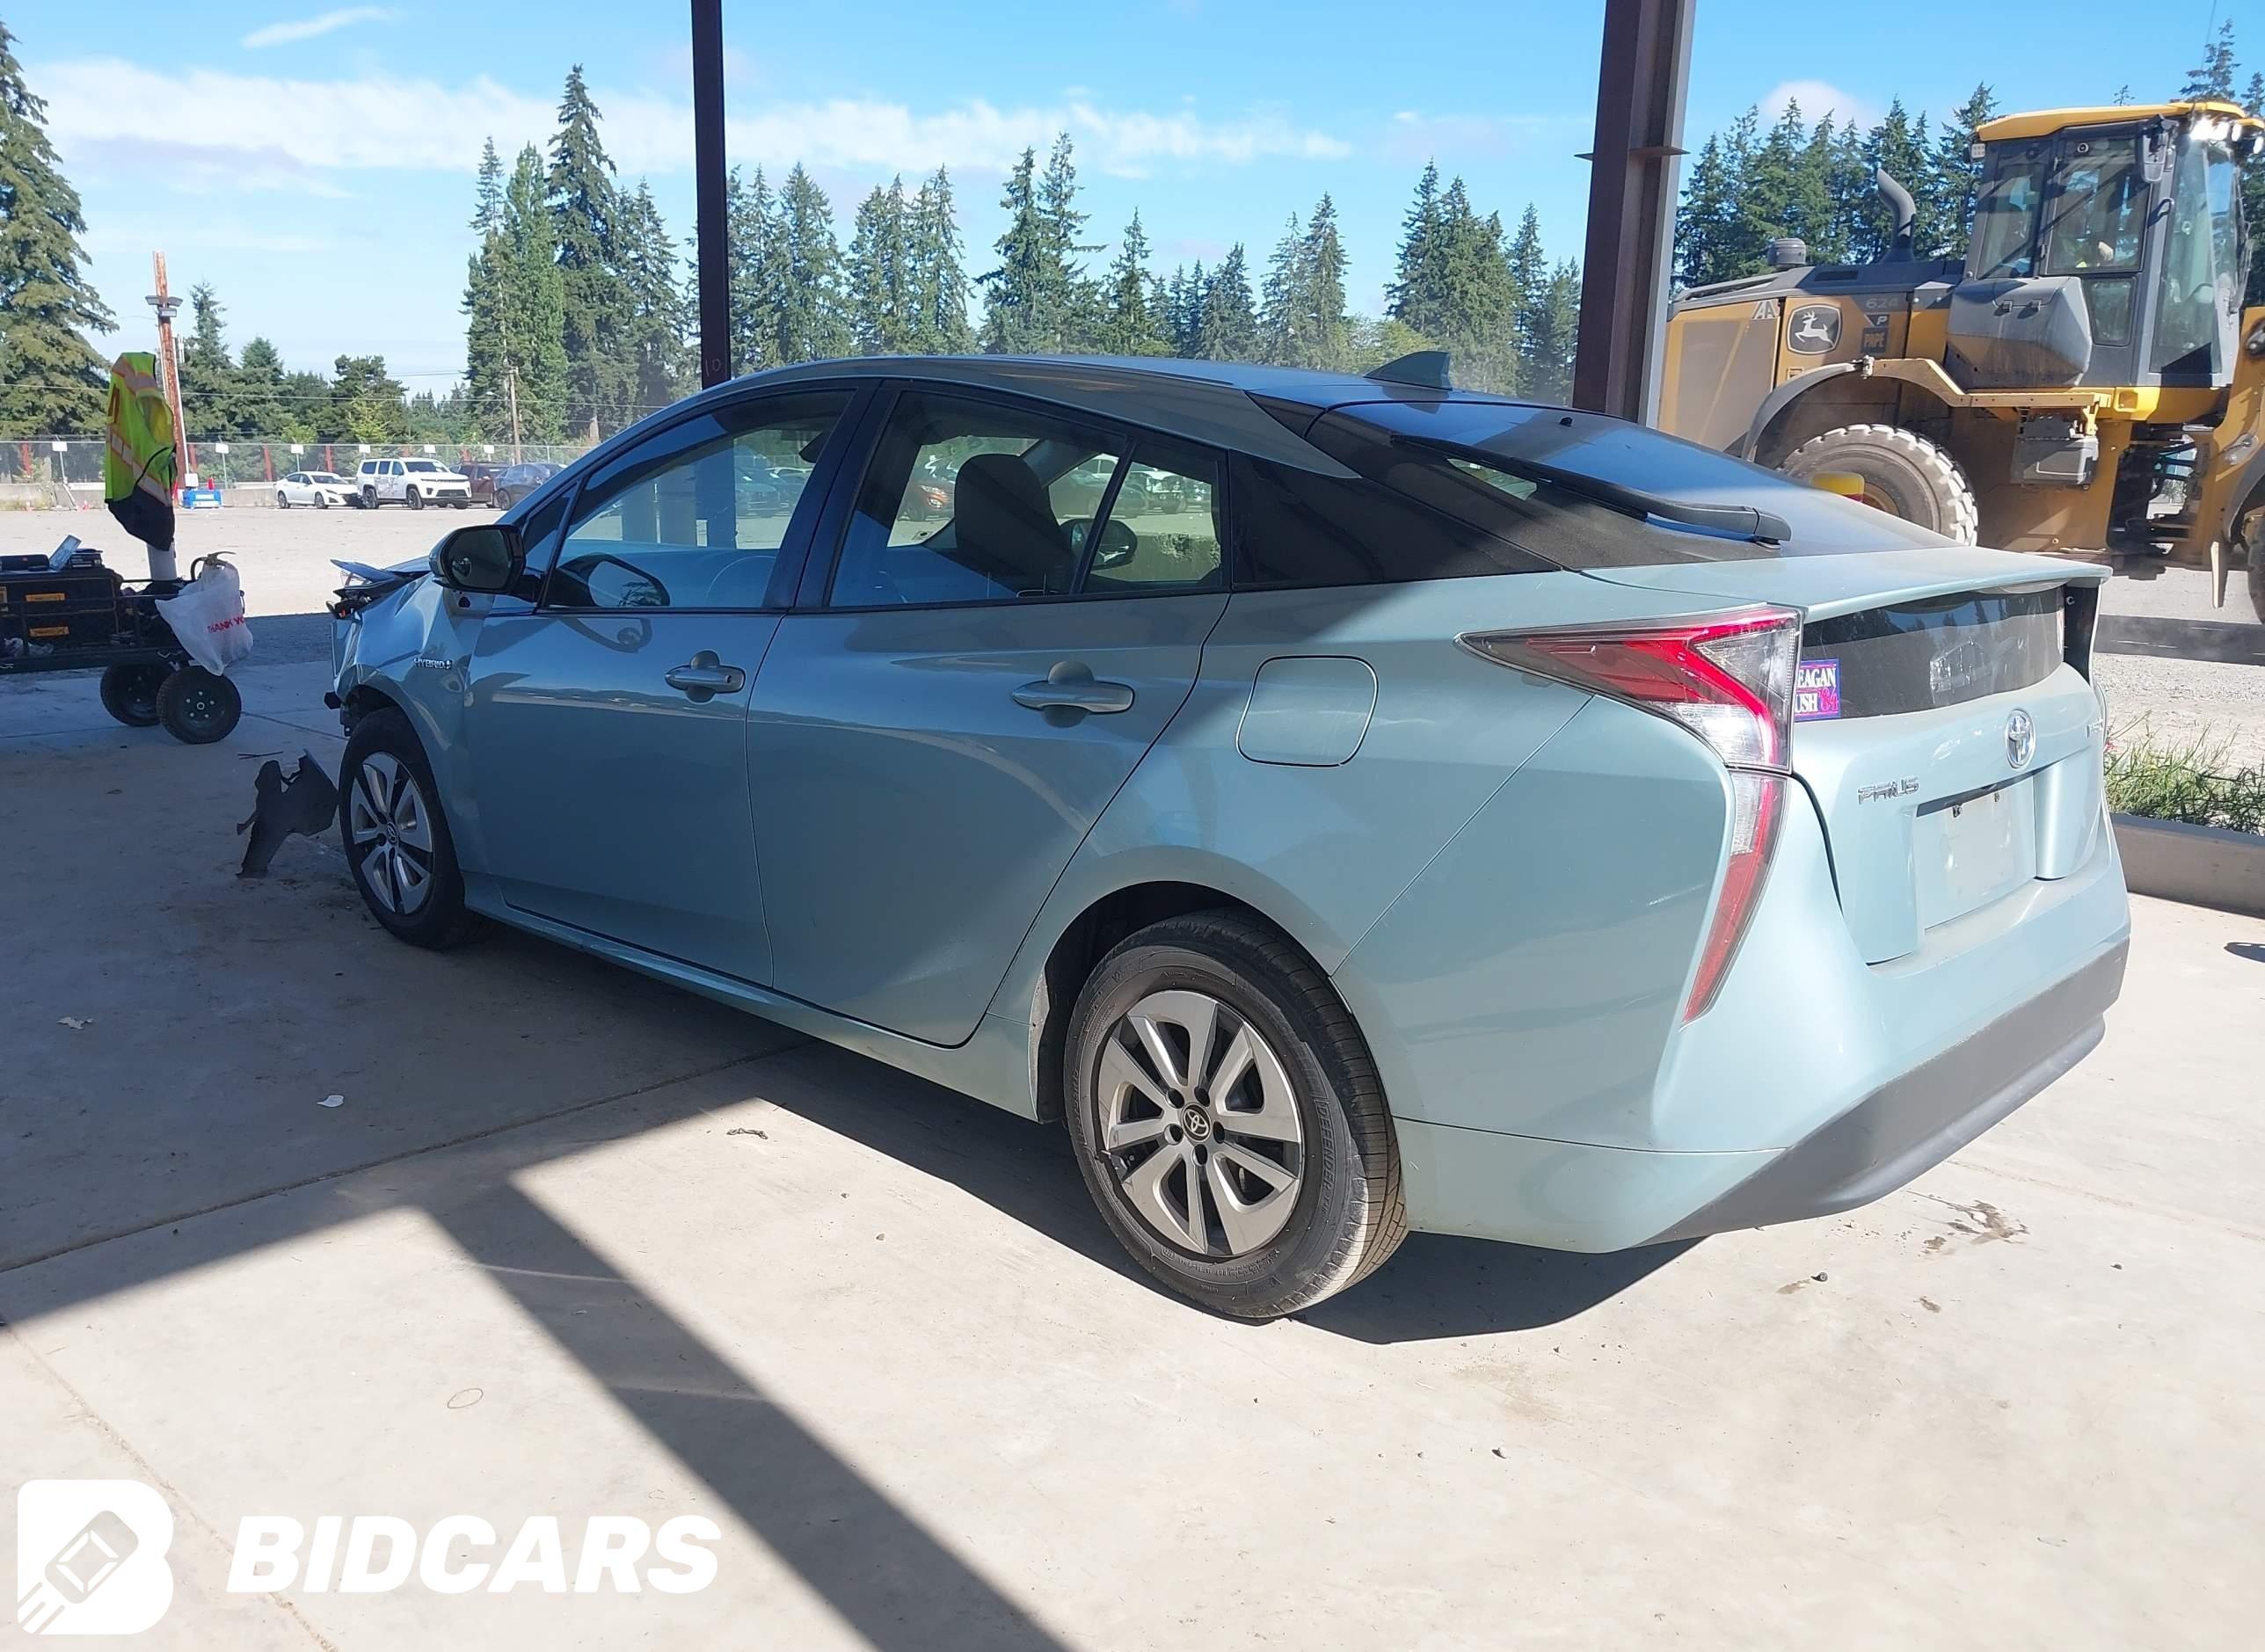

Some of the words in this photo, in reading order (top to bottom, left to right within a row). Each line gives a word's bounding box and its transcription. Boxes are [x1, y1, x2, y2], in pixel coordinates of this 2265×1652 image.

[1876, 316, 1888, 325] P
[413, 658, 445, 669] HYBRID
[1798, 667, 1836, 688] EAGAN
[1795, 692, 1818, 713] USH
[1857, 776, 1919, 805] PRIUS
[1318, 1101, 1335, 1190] DEFENDER
